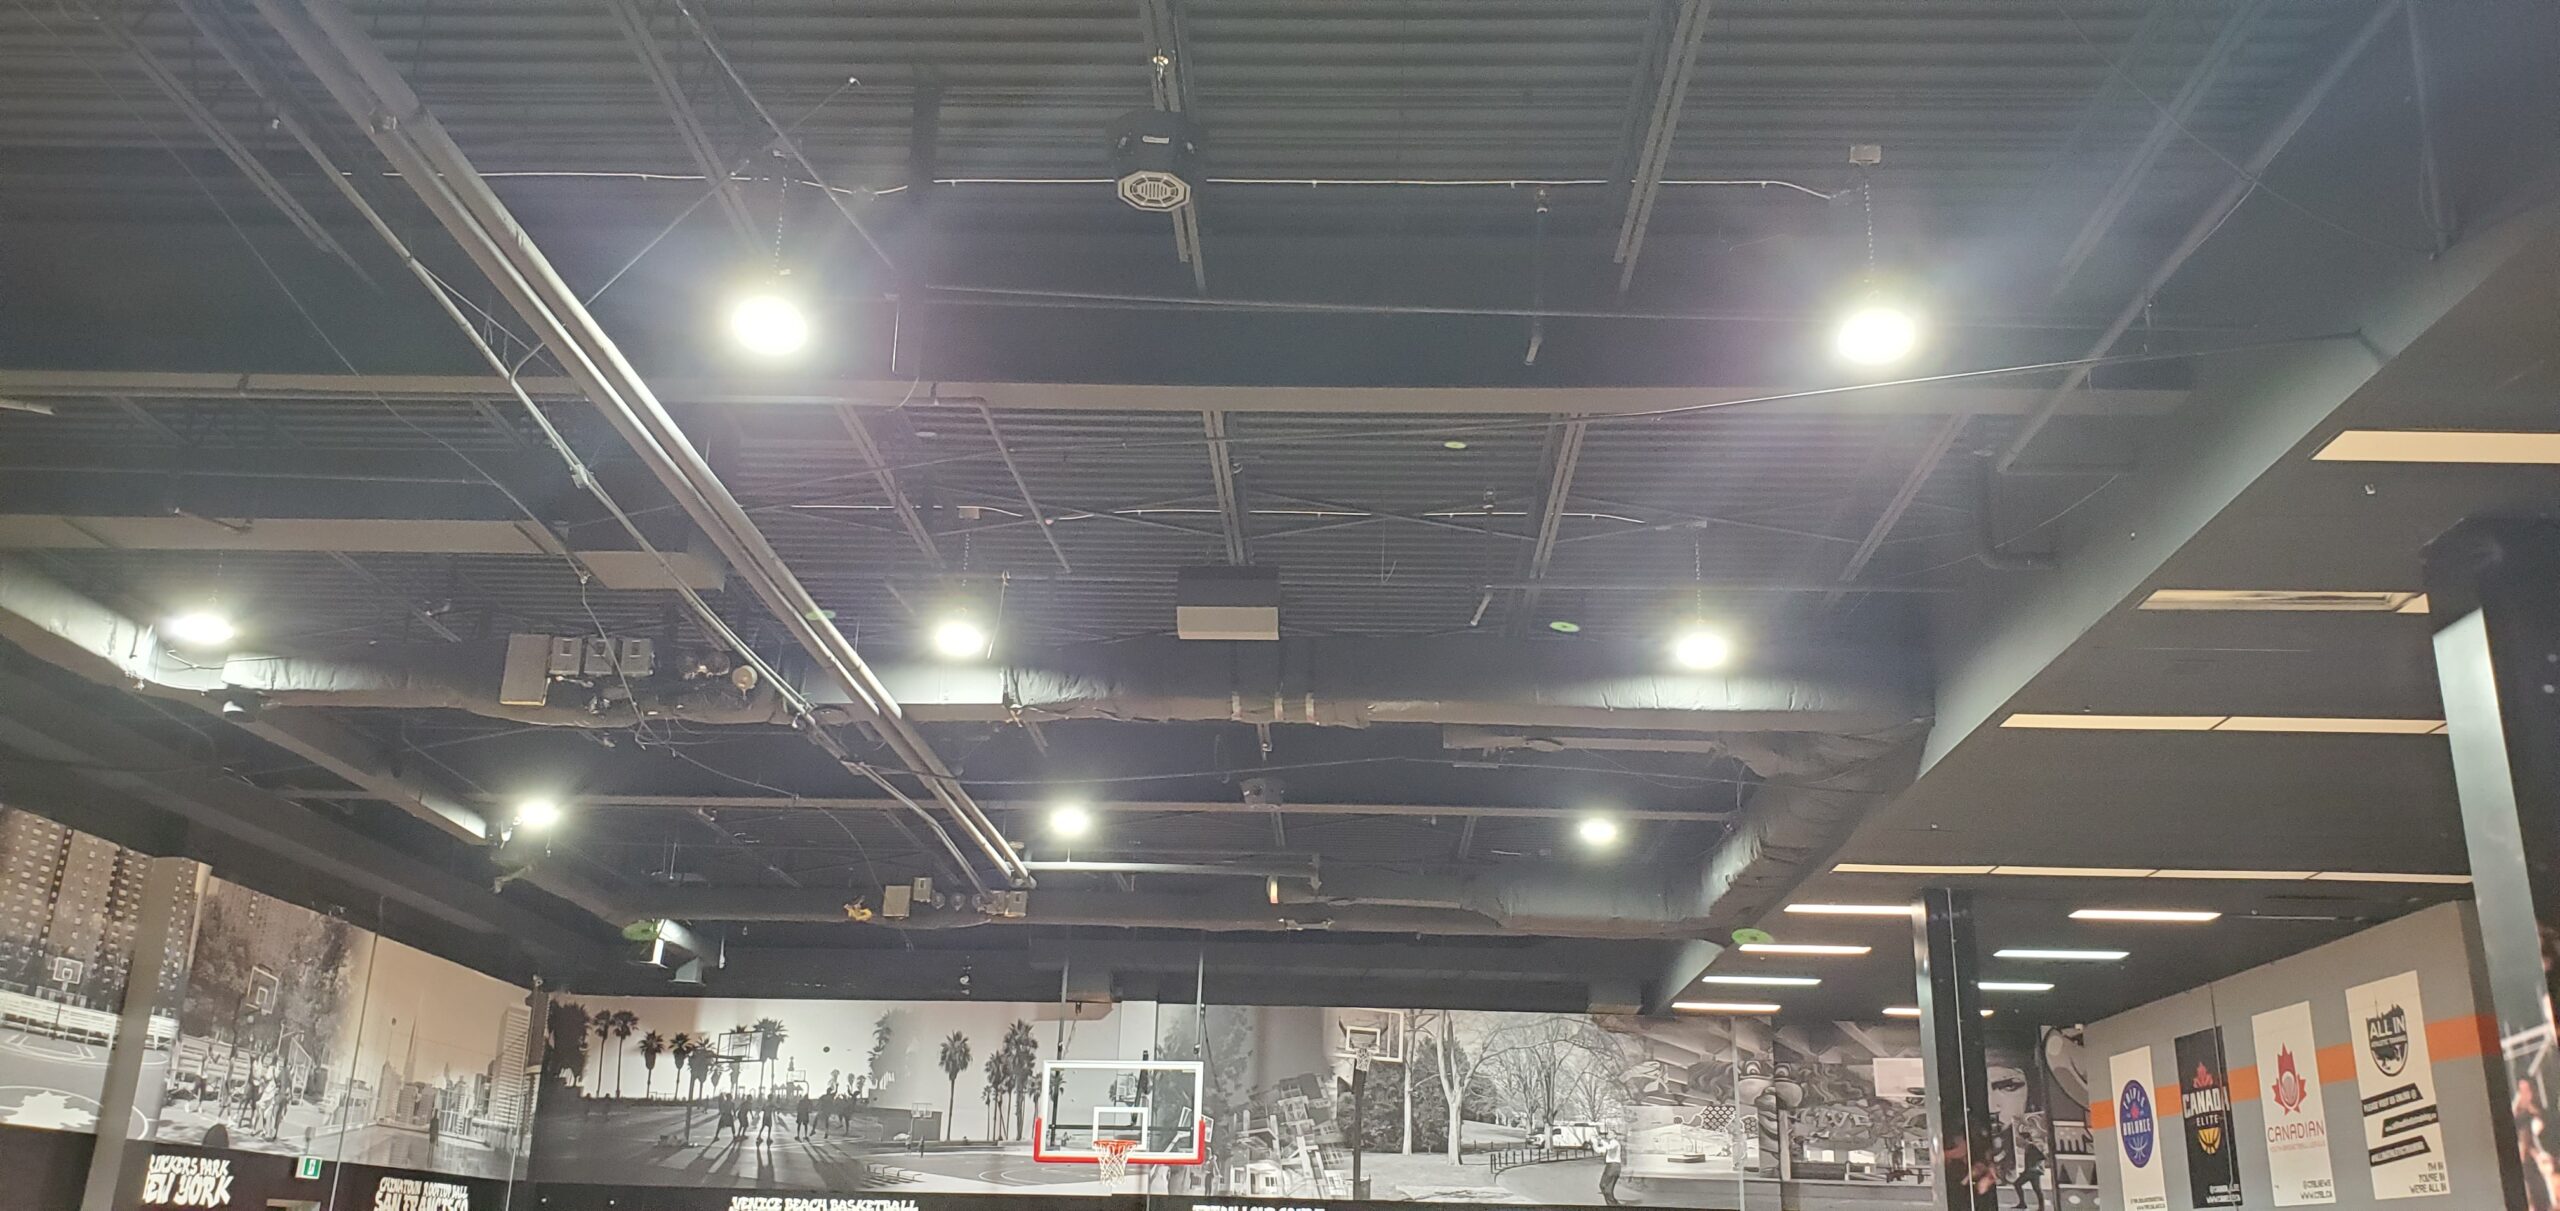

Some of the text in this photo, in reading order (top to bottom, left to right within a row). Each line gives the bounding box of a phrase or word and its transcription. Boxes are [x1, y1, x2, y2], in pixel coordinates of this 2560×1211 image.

[2370, 1015, 2406, 1039] ALL IN
[2182, 1086, 2231, 1119] CANADA
[2196, 1114, 2219, 1127] ELITE
[2267, 1120, 2325, 1143] CANADIAN
[200, 1157, 231, 1178] PARK
[173, 1173, 234, 1208] YORK
[2428, 1183, 2440, 1193] ALL
[374, 1190, 402, 1211] SAN
[731, 1196, 919, 1211] VENICE BEACH BASKETBALL
